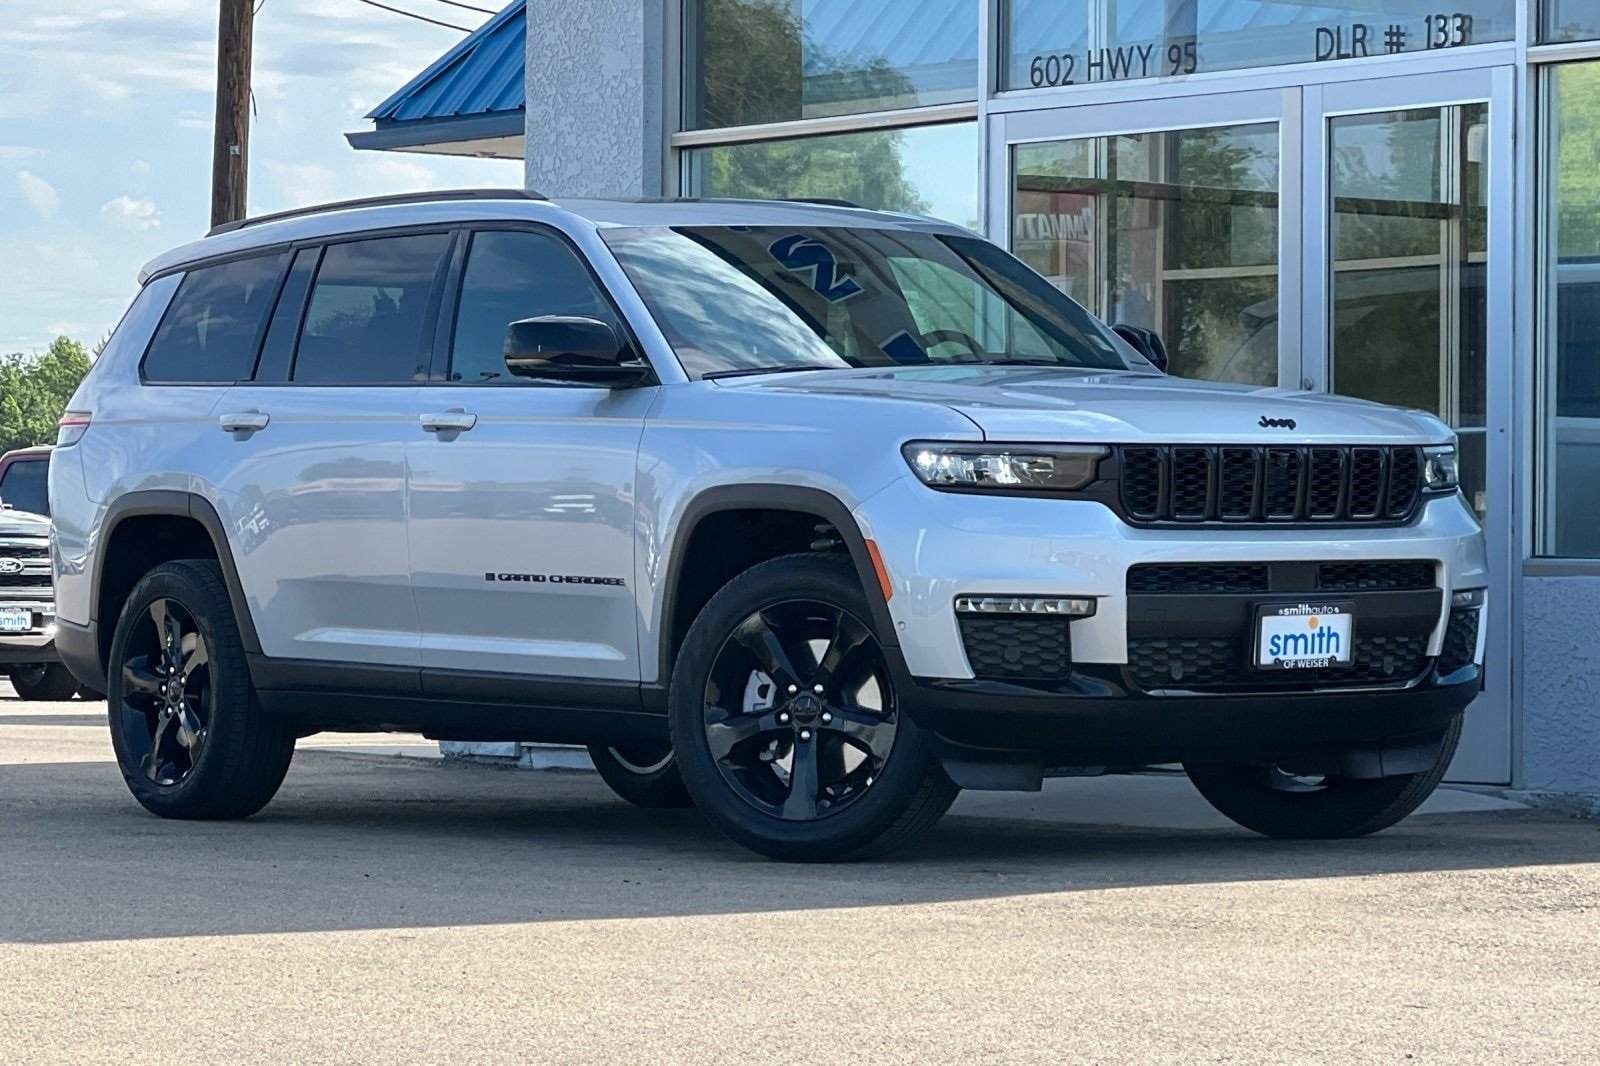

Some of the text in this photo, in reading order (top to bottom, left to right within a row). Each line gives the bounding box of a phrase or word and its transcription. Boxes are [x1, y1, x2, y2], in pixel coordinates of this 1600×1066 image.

[1316, 13, 1468, 61] DLR # 133
[1030, 41, 1198, 87] 602 HWY 95
[1258, 416, 1296, 430] Jeep
[498, 573, 626, 587] GRAND CHEROKEE
[1269, 616, 1340, 656] smith
[1283, 658, 1329, 669] OF WEISER
